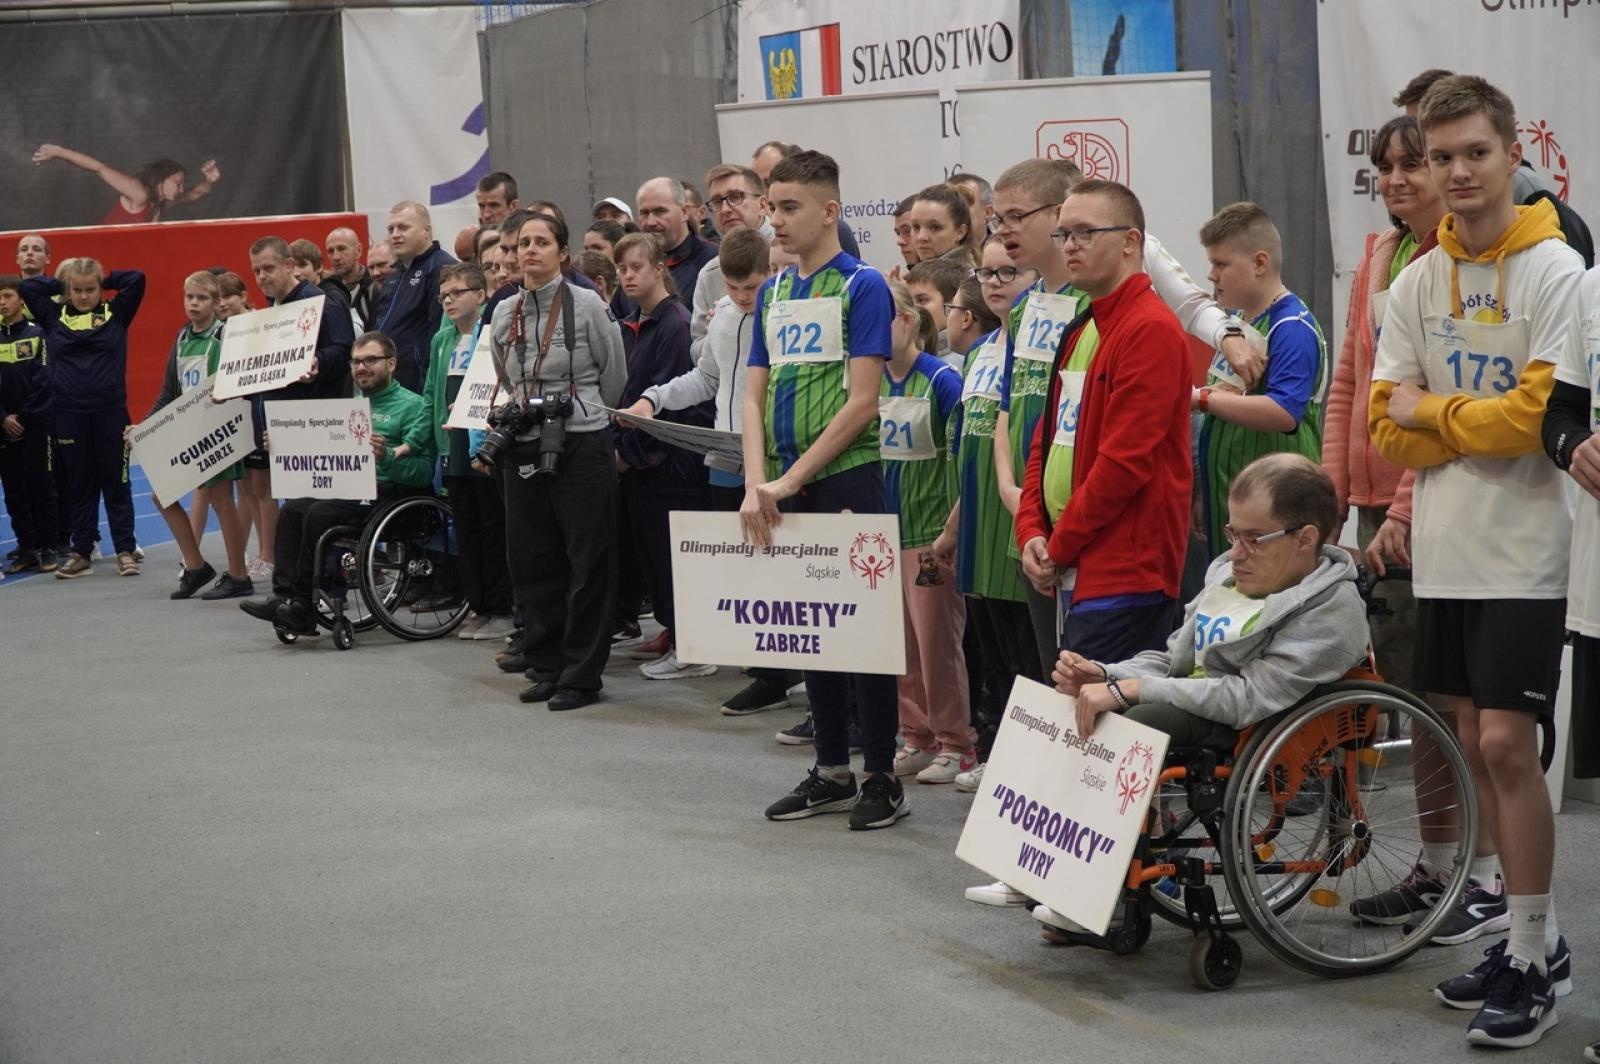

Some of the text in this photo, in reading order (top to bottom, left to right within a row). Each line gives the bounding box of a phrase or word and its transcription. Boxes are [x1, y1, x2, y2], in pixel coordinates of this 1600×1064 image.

[853, 21, 1013, 85] STAROSTWO
[1353, 168, 1380, 202] Sp
[777, 322, 822, 356] 122
[237, 375, 258, 388] RUDA
[1446, 350, 1518, 394] 173
[134, 413, 175, 443] Olimpiady
[270, 417, 345, 429] Olimpiady Specjalne
[196, 442, 235, 473] ZABRZE
[275, 454, 370, 472] "KONICZYNKA"
[312, 472, 333, 489] ŻORY
[679, 540, 839, 560] Olimpiady Specjalne
[805, 562, 841, 581] Śląskie
[716, 598, 857, 628] "KOMETY"
[754, 632, 821, 655] ZABRZE
[1009, 705, 1116, 763] Olimpiady Specjalne
[1080, 765, 1107, 791] Śląskie
[992, 783, 1116, 865] "POGROMCY"
[1017, 842, 1055, 880] WYRY
